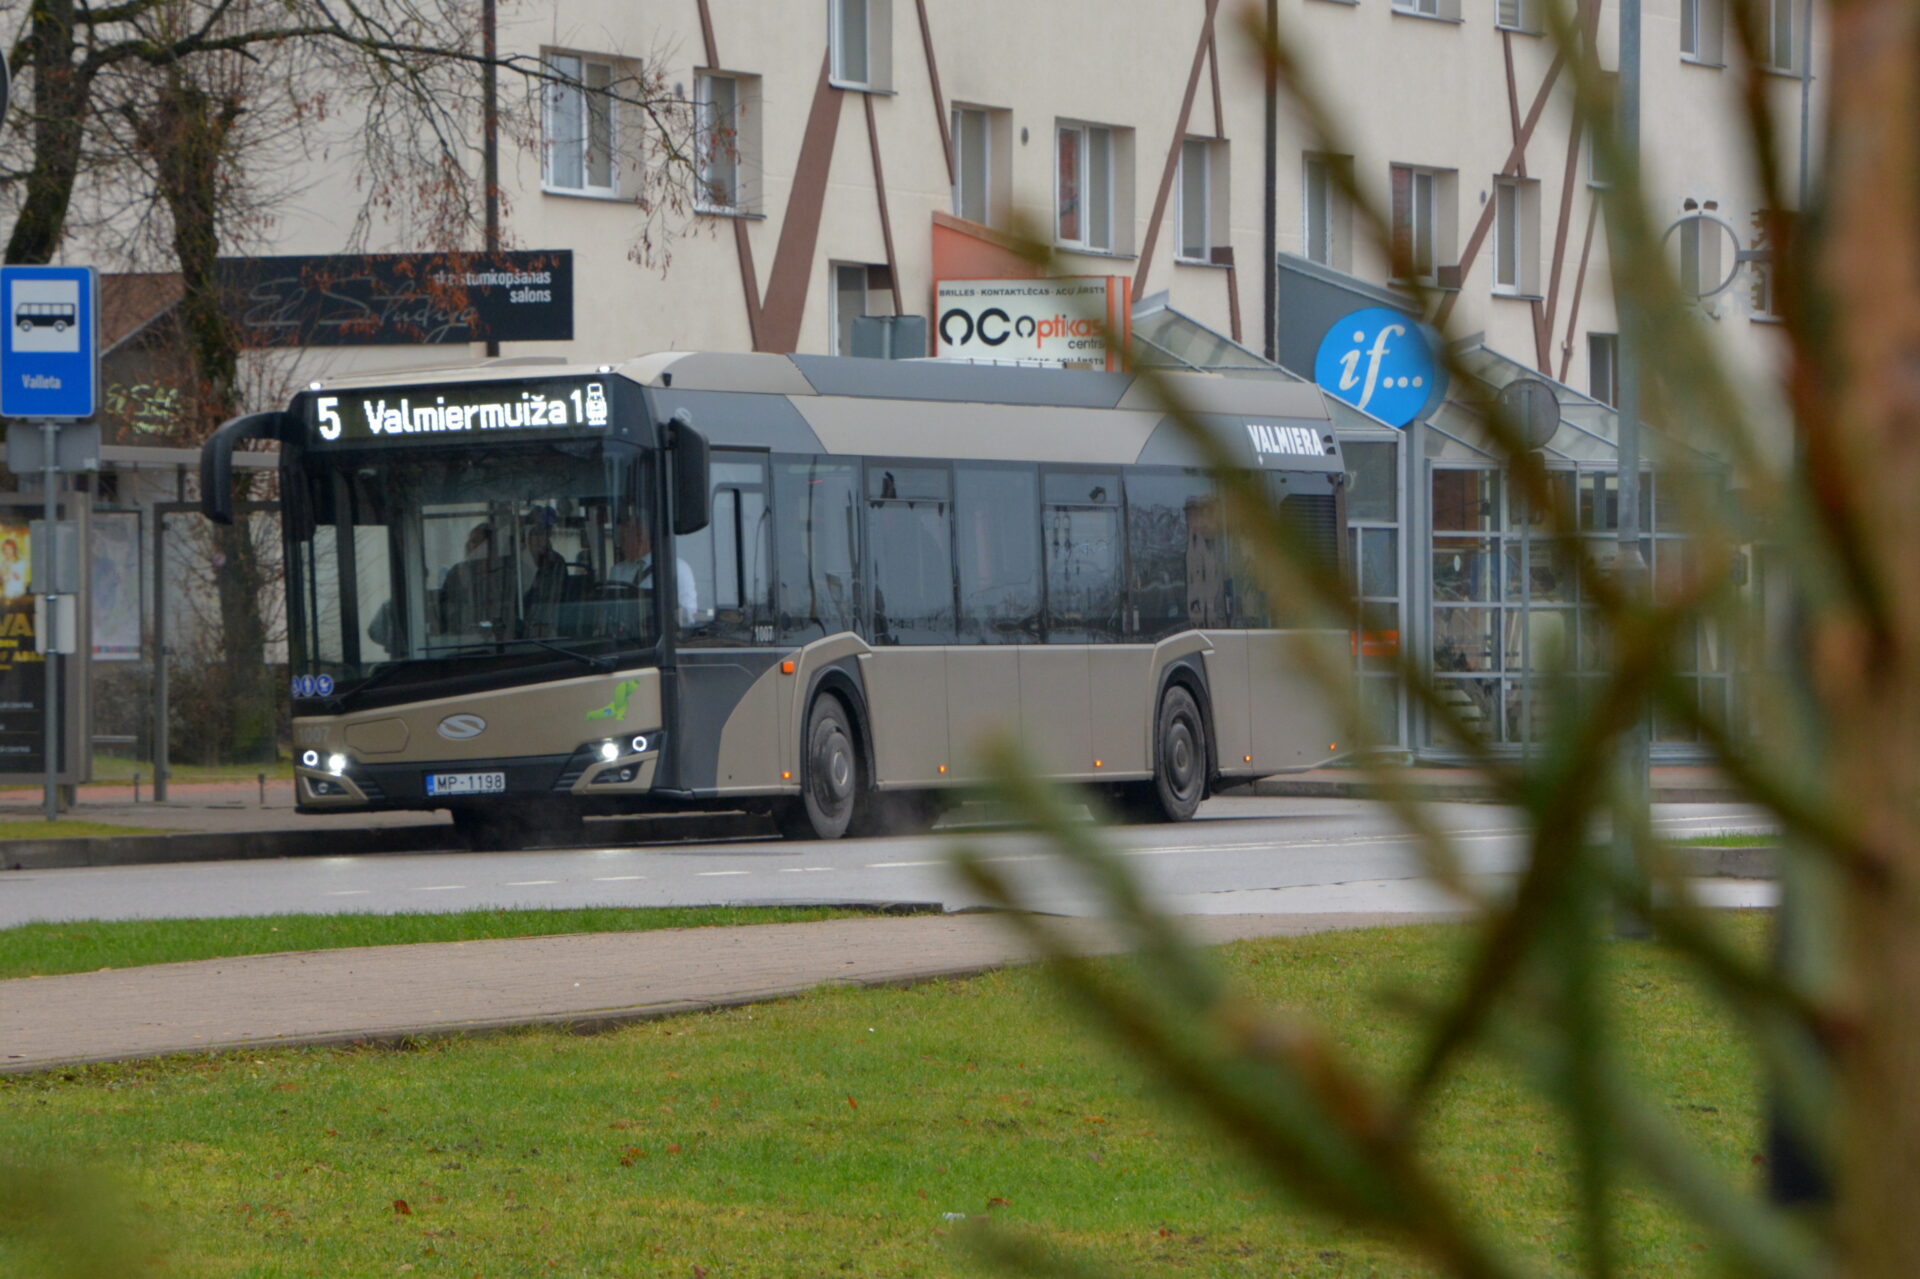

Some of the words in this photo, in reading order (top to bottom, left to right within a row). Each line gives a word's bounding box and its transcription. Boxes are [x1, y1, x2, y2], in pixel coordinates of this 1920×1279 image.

[510, 287, 552, 303] salons
[939, 287, 975, 297] BRILLES
[981, 286, 1050, 296] KONTAKTLĒCAS
[1068, 338, 1105, 350] centrs
[317, 397, 341, 441] 5
[363, 391, 567, 435] Valmiermuiža
[1246, 424, 1325, 457] VALMIERA
[437, 774, 502, 791] MP-1198
